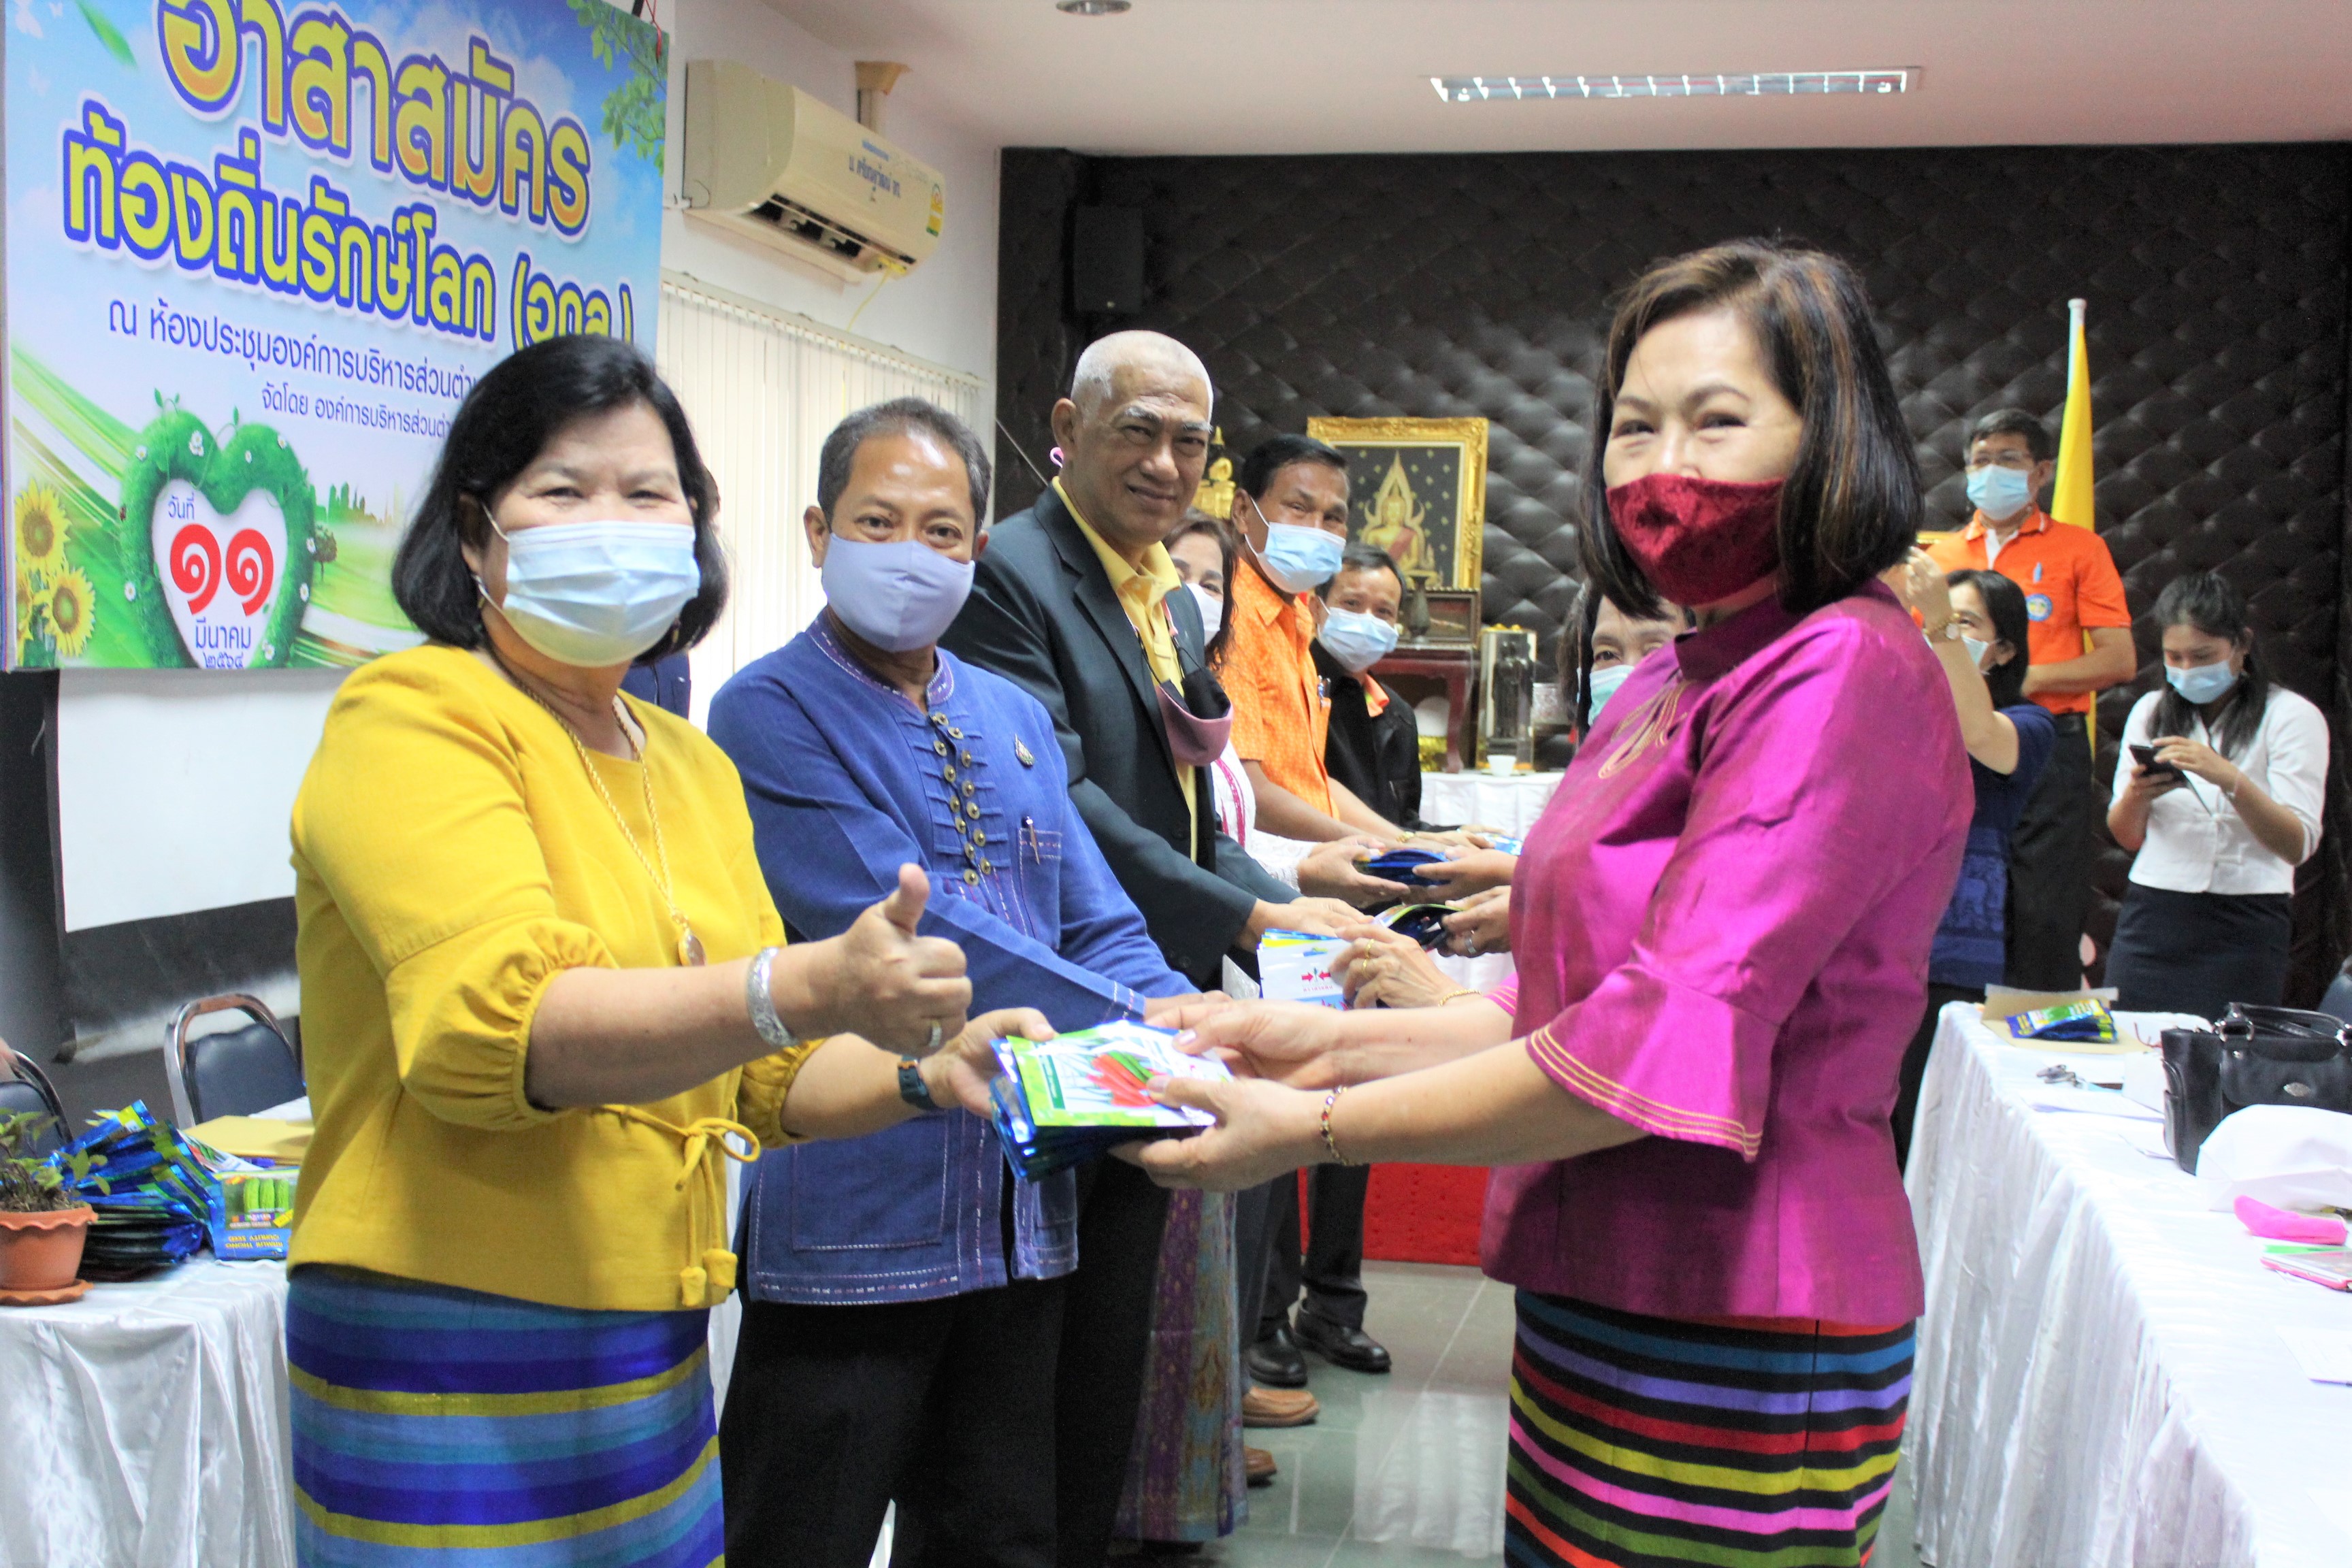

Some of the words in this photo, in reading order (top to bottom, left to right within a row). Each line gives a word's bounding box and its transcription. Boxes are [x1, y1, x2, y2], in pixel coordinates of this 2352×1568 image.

[160, 0, 590, 235] อาสาสมัคร
[64, 101, 495, 342] ท้องถิ่นรักษ์โลก
[110, 299, 137, 336] ณ
[150, 297, 477, 400] ห้องประชุมองค์การบริหารส่วนตำ
[262, 381, 308, 415] จัดโดย
[168, 492, 195, 520] วันที่
[169, 523, 274, 617] ๑๑
[195, 617, 252, 649] มีนาคม
